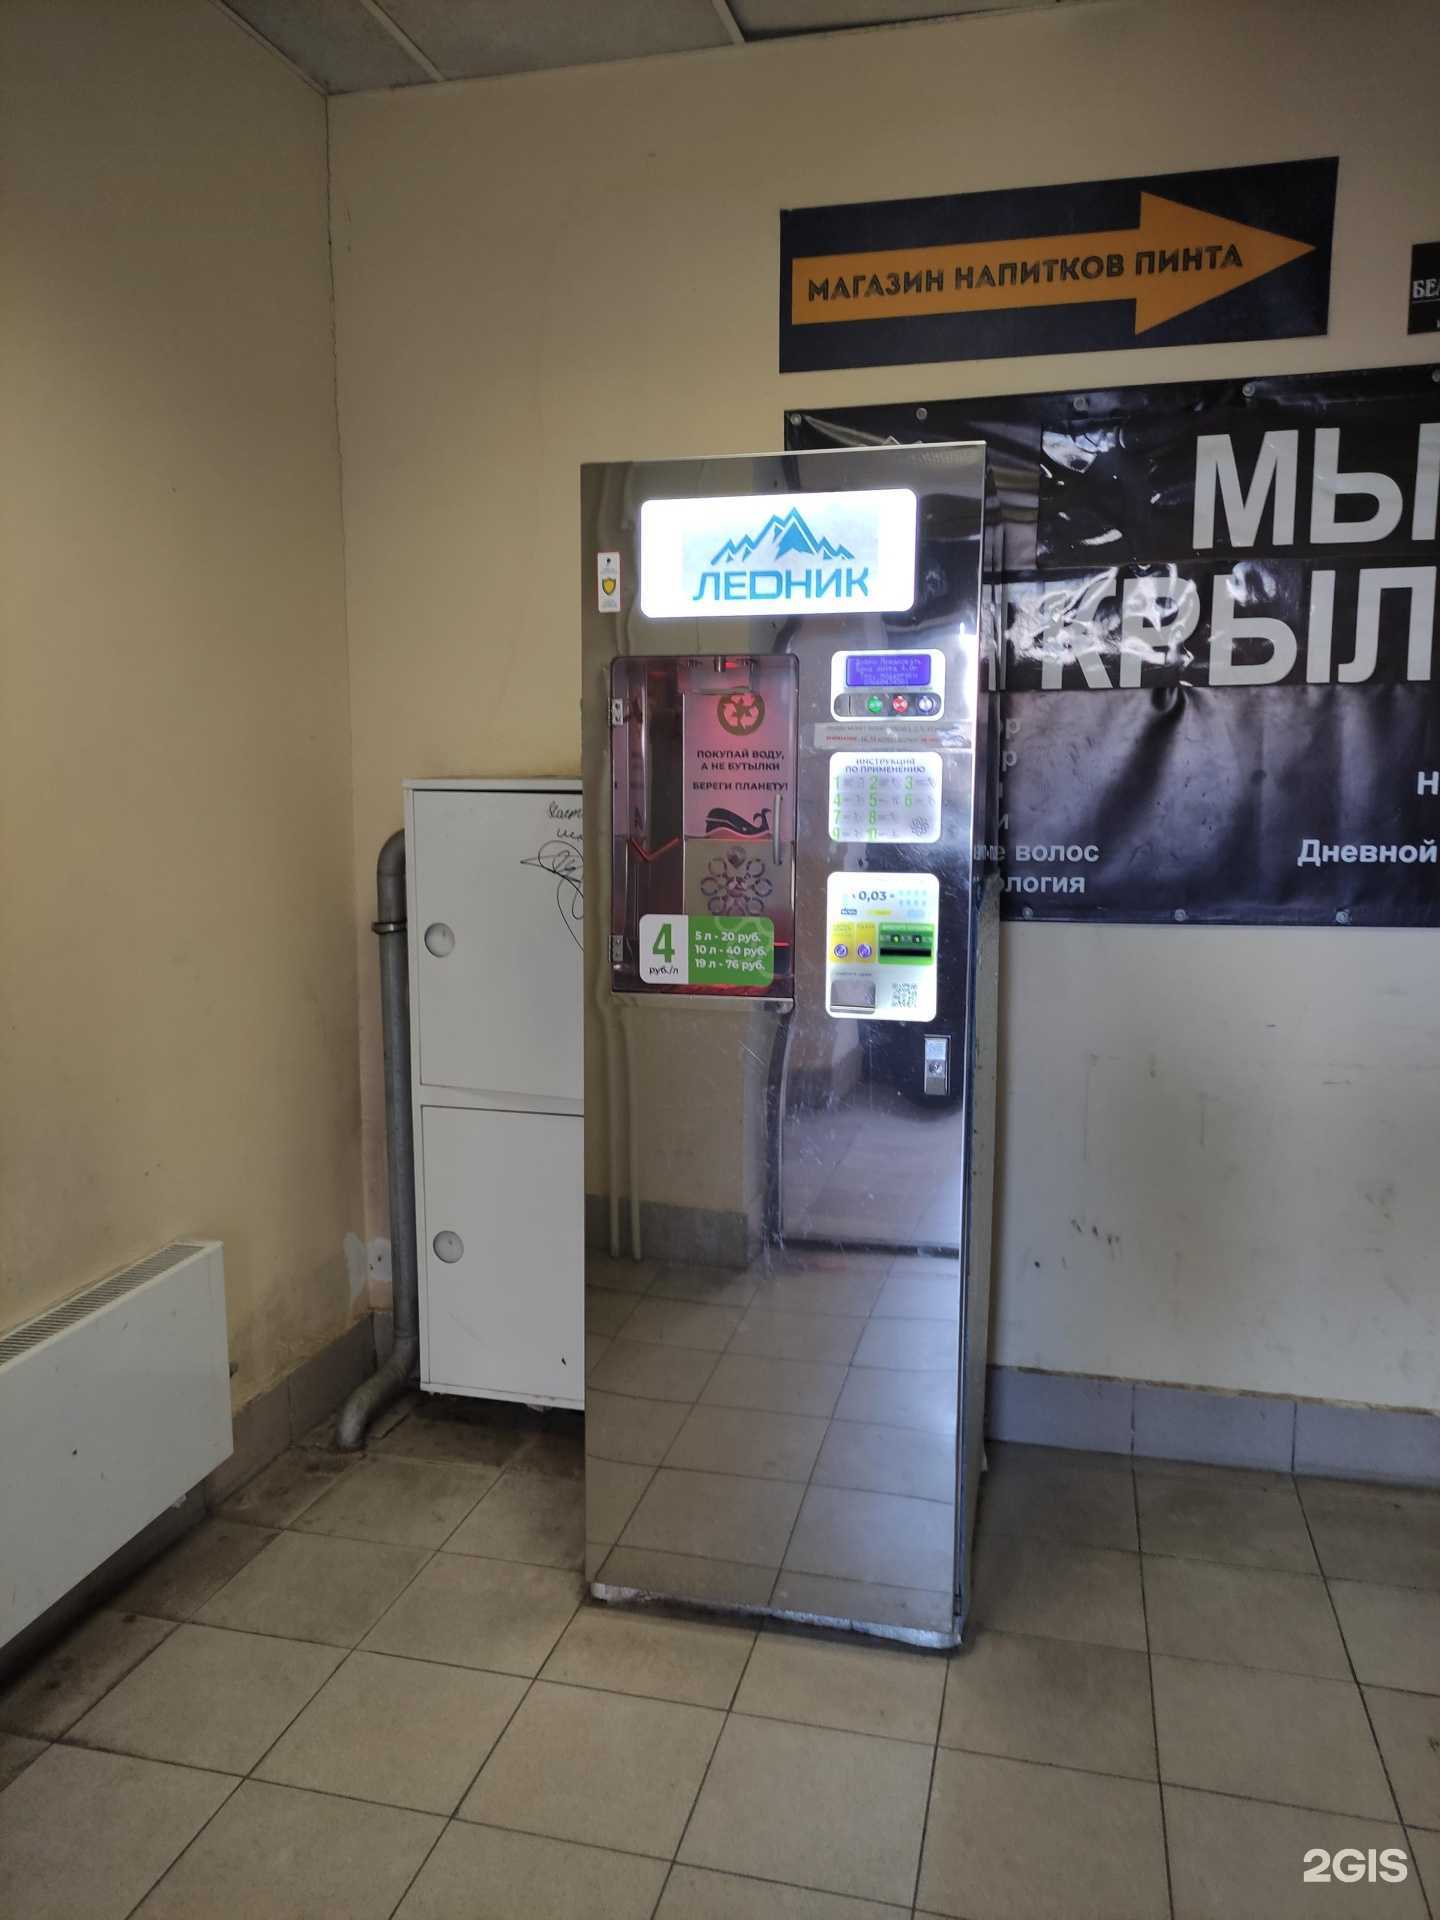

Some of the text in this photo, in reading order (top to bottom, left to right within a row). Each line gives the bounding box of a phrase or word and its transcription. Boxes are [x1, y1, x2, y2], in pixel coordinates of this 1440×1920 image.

[808, 243, 1244, 302] МАГАЗИН НАПИТКОВ ПИНТА
[1192, 422, 1440, 549] МЫ
[697, 749, 784, 760] ПОКУПАЙ ВОДУ,
[728, 762, 780, 771] БУТЫЛКИ
[692, 782, 732, 790] БЕРЕГИ
[1015, 845, 1100, 862] волос
[1297, 838, 1437, 867] Дневной
[858, 890, 887, 902] 0,03
[652, 923, 675, 963] 4
[695, 931, 702, 941] 5
[704, 933, 712, 941] л
[721, 931, 735, 941] 20
[738, 931, 761, 944] руб.
[695, 944, 706, 955] 10
[708, 946, 717, 955] л
[726, 946, 740, 955] 40
[743, 946, 767, 957] руб.
[695, 958, 706, 968] 19
[708, 960, 716, 968] л
[742, 960, 765, 971] руб.
